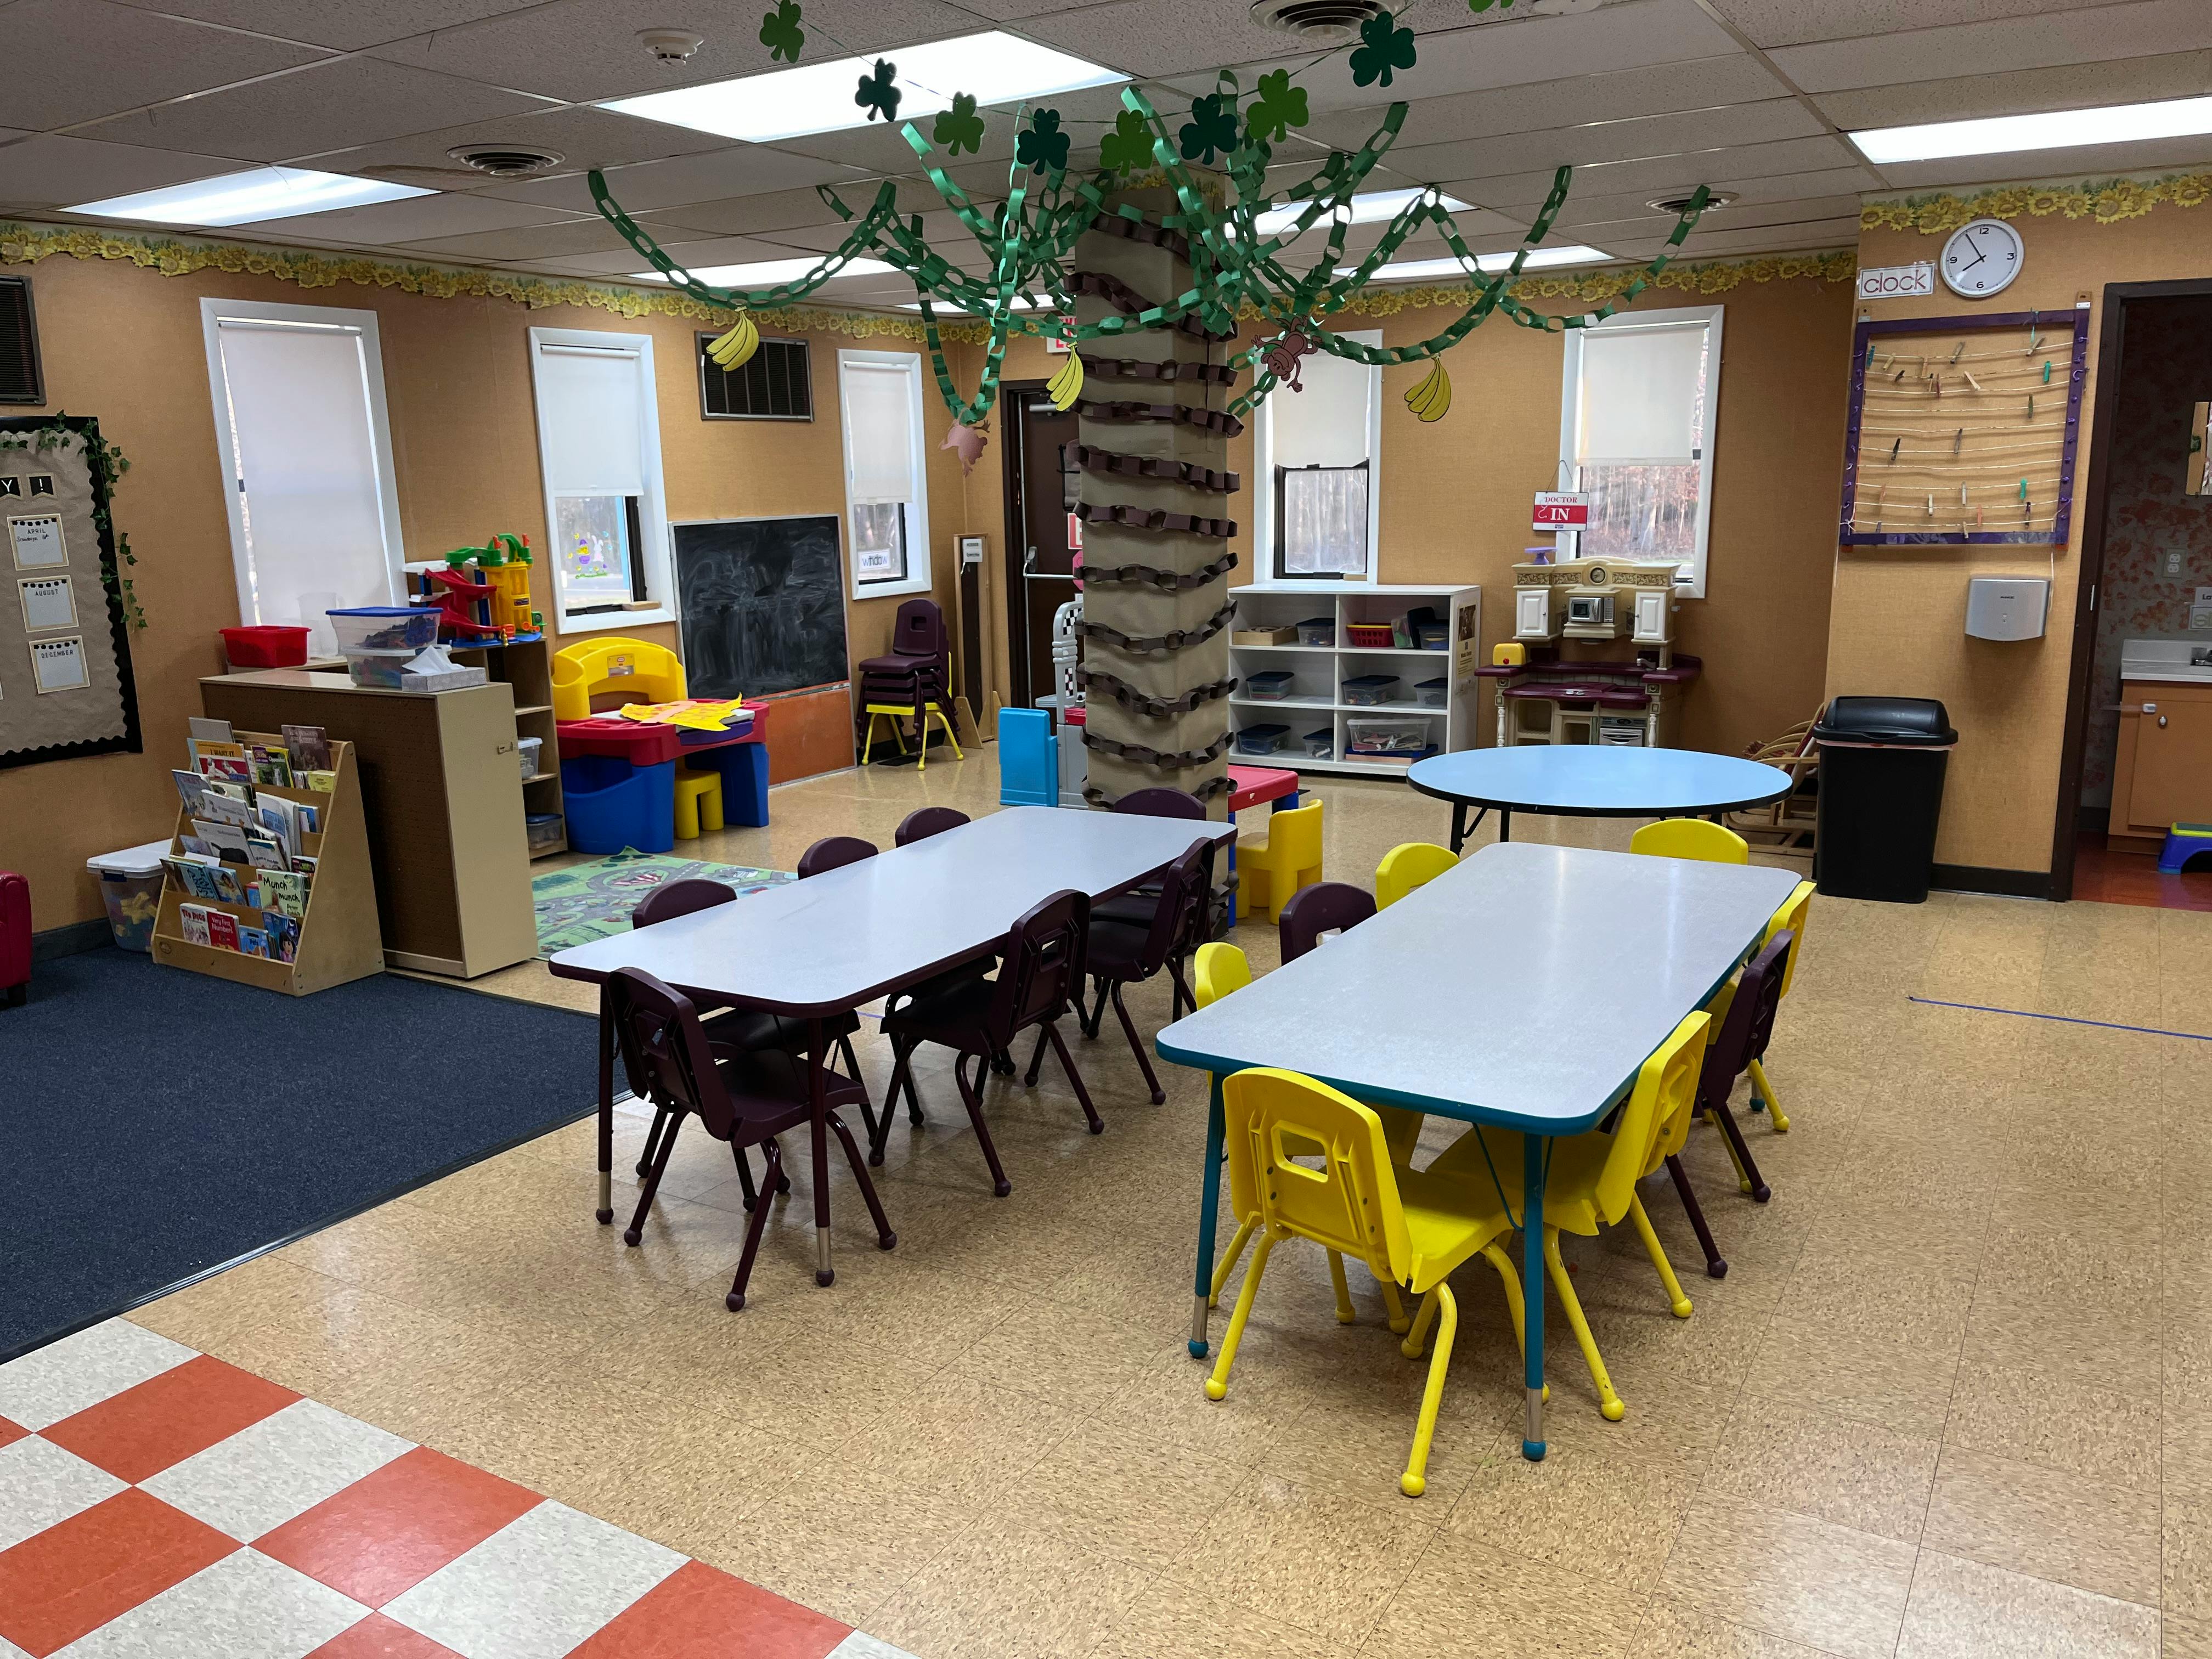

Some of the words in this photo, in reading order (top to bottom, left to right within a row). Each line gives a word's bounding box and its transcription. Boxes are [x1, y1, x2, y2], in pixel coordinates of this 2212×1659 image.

[1864, 269, 1926, 293] clock
[1550, 507, 1570, 521] IN
[862, 554, 887, 567] window
[41, 650, 74, 658] DECEMBER
[263, 877, 287, 890] Munch
[211, 917, 222, 926] Very
[211, 923, 233, 934] Numbers
